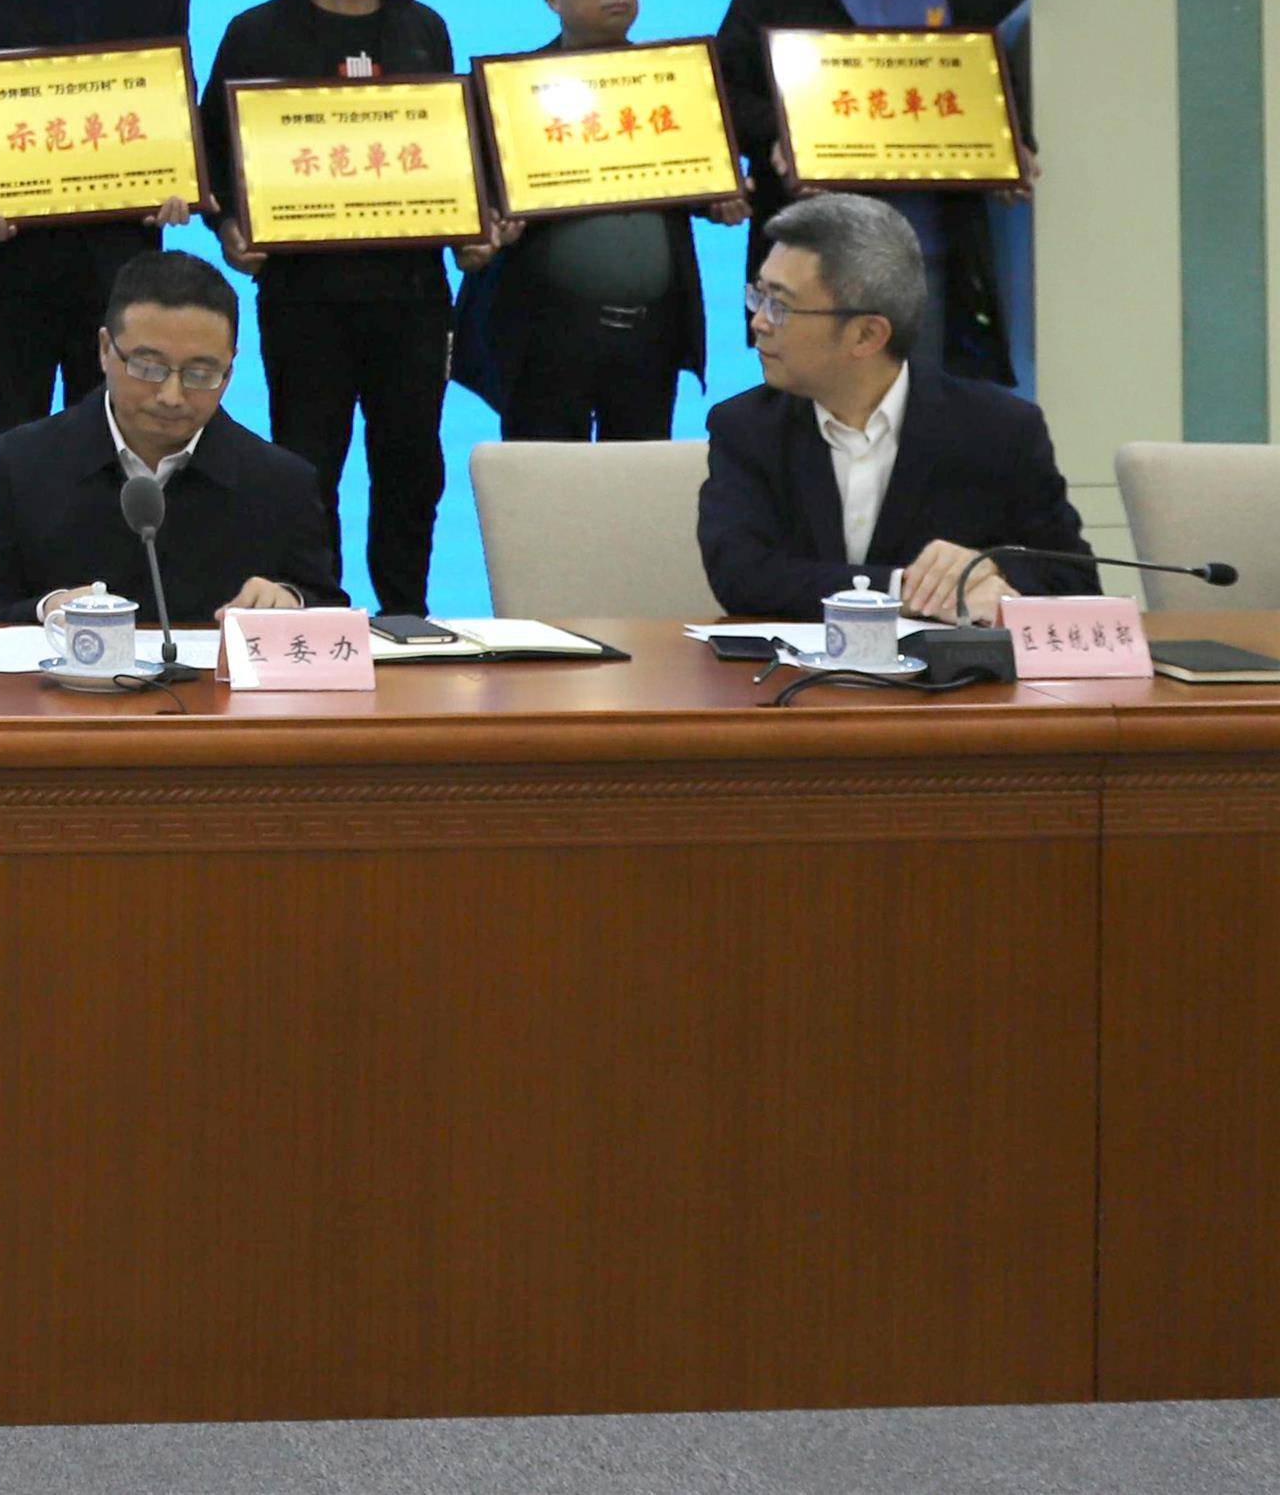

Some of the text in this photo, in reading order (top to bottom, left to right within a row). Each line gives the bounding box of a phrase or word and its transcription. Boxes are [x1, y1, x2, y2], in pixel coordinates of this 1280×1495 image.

[544, 104, 681, 144] 示范单位
[832, 87, 965, 122] 示范单位
[6, 112, 148, 154] 示范单位
[291, 142, 430, 180] 示范单位
